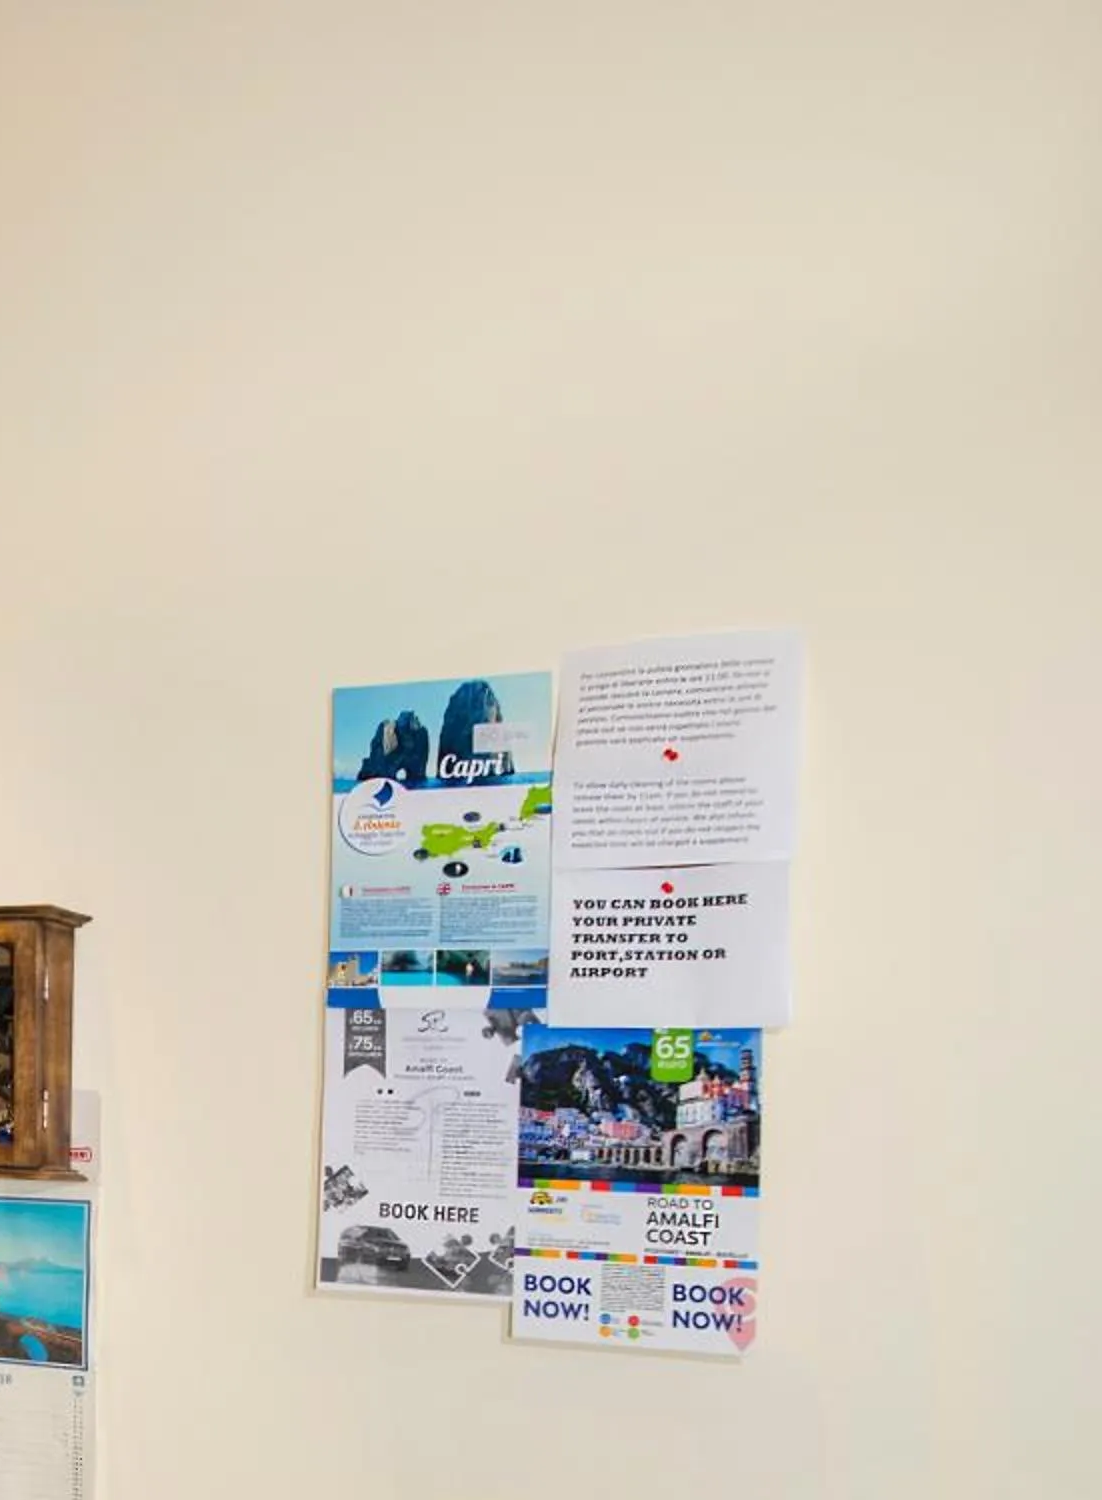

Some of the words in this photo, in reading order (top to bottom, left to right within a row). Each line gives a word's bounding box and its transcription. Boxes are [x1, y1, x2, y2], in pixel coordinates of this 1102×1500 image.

[439, 752, 504, 785] Capri
[573, 899, 607, 910] YOU
[611, 899, 646, 910] CAN
[650, 897, 699, 910] BOOK
[702, 893, 749, 907] HERE
[572, 916, 619, 927] YOUR
[622, 914, 698, 927] PRIVATE
[572, 932, 662, 944] TRANSFER
[665, 932, 689, 944] TO
[701, 947, 727, 960] OR
[570, 966, 649, 978] AIRPORT
[353, 1009, 374, 1025] 65
[353, 1035, 374, 1051] 75
[656, 1035, 691, 1059] 65
[379, 1202, 429, 1221] BOOK
[433, 1206, 480, 1223] HERE
[647, 1197, 689, 1209] ROAD
[693, 1198, 714, 1211] TO
[646, 1210, 720, 1229] AMALFI
[646, 1229, 713, 1246] COAST
[524, 1273, 592, 1297] BOOK
[672, 1283, 746, 1306] BOOK
[523, 1299, 590, 1321] NOW!
[672, 1310, 743, 1333] NOW!
